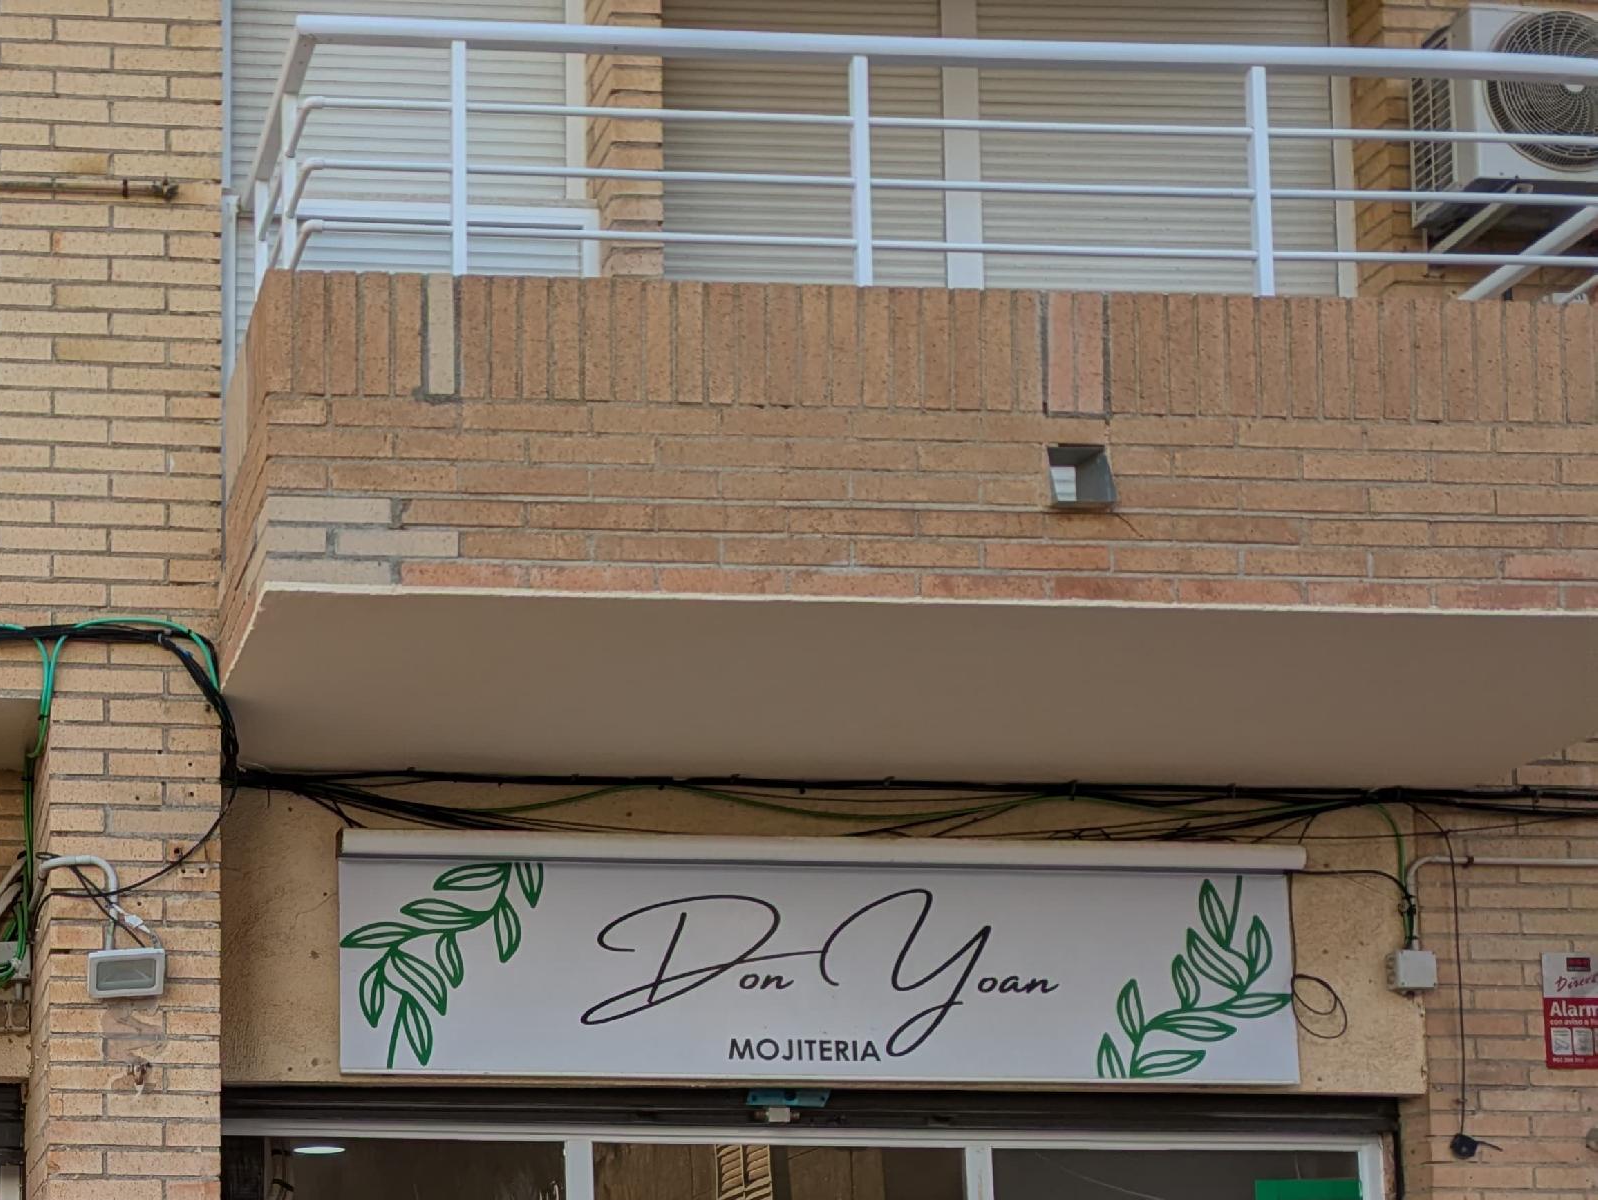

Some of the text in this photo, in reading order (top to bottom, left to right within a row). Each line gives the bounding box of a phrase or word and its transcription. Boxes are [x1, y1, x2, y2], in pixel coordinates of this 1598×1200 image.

[580, 888, 1060, 1056] Don Yoan
[727, 1037, 882, 1062] MOJITERIA
